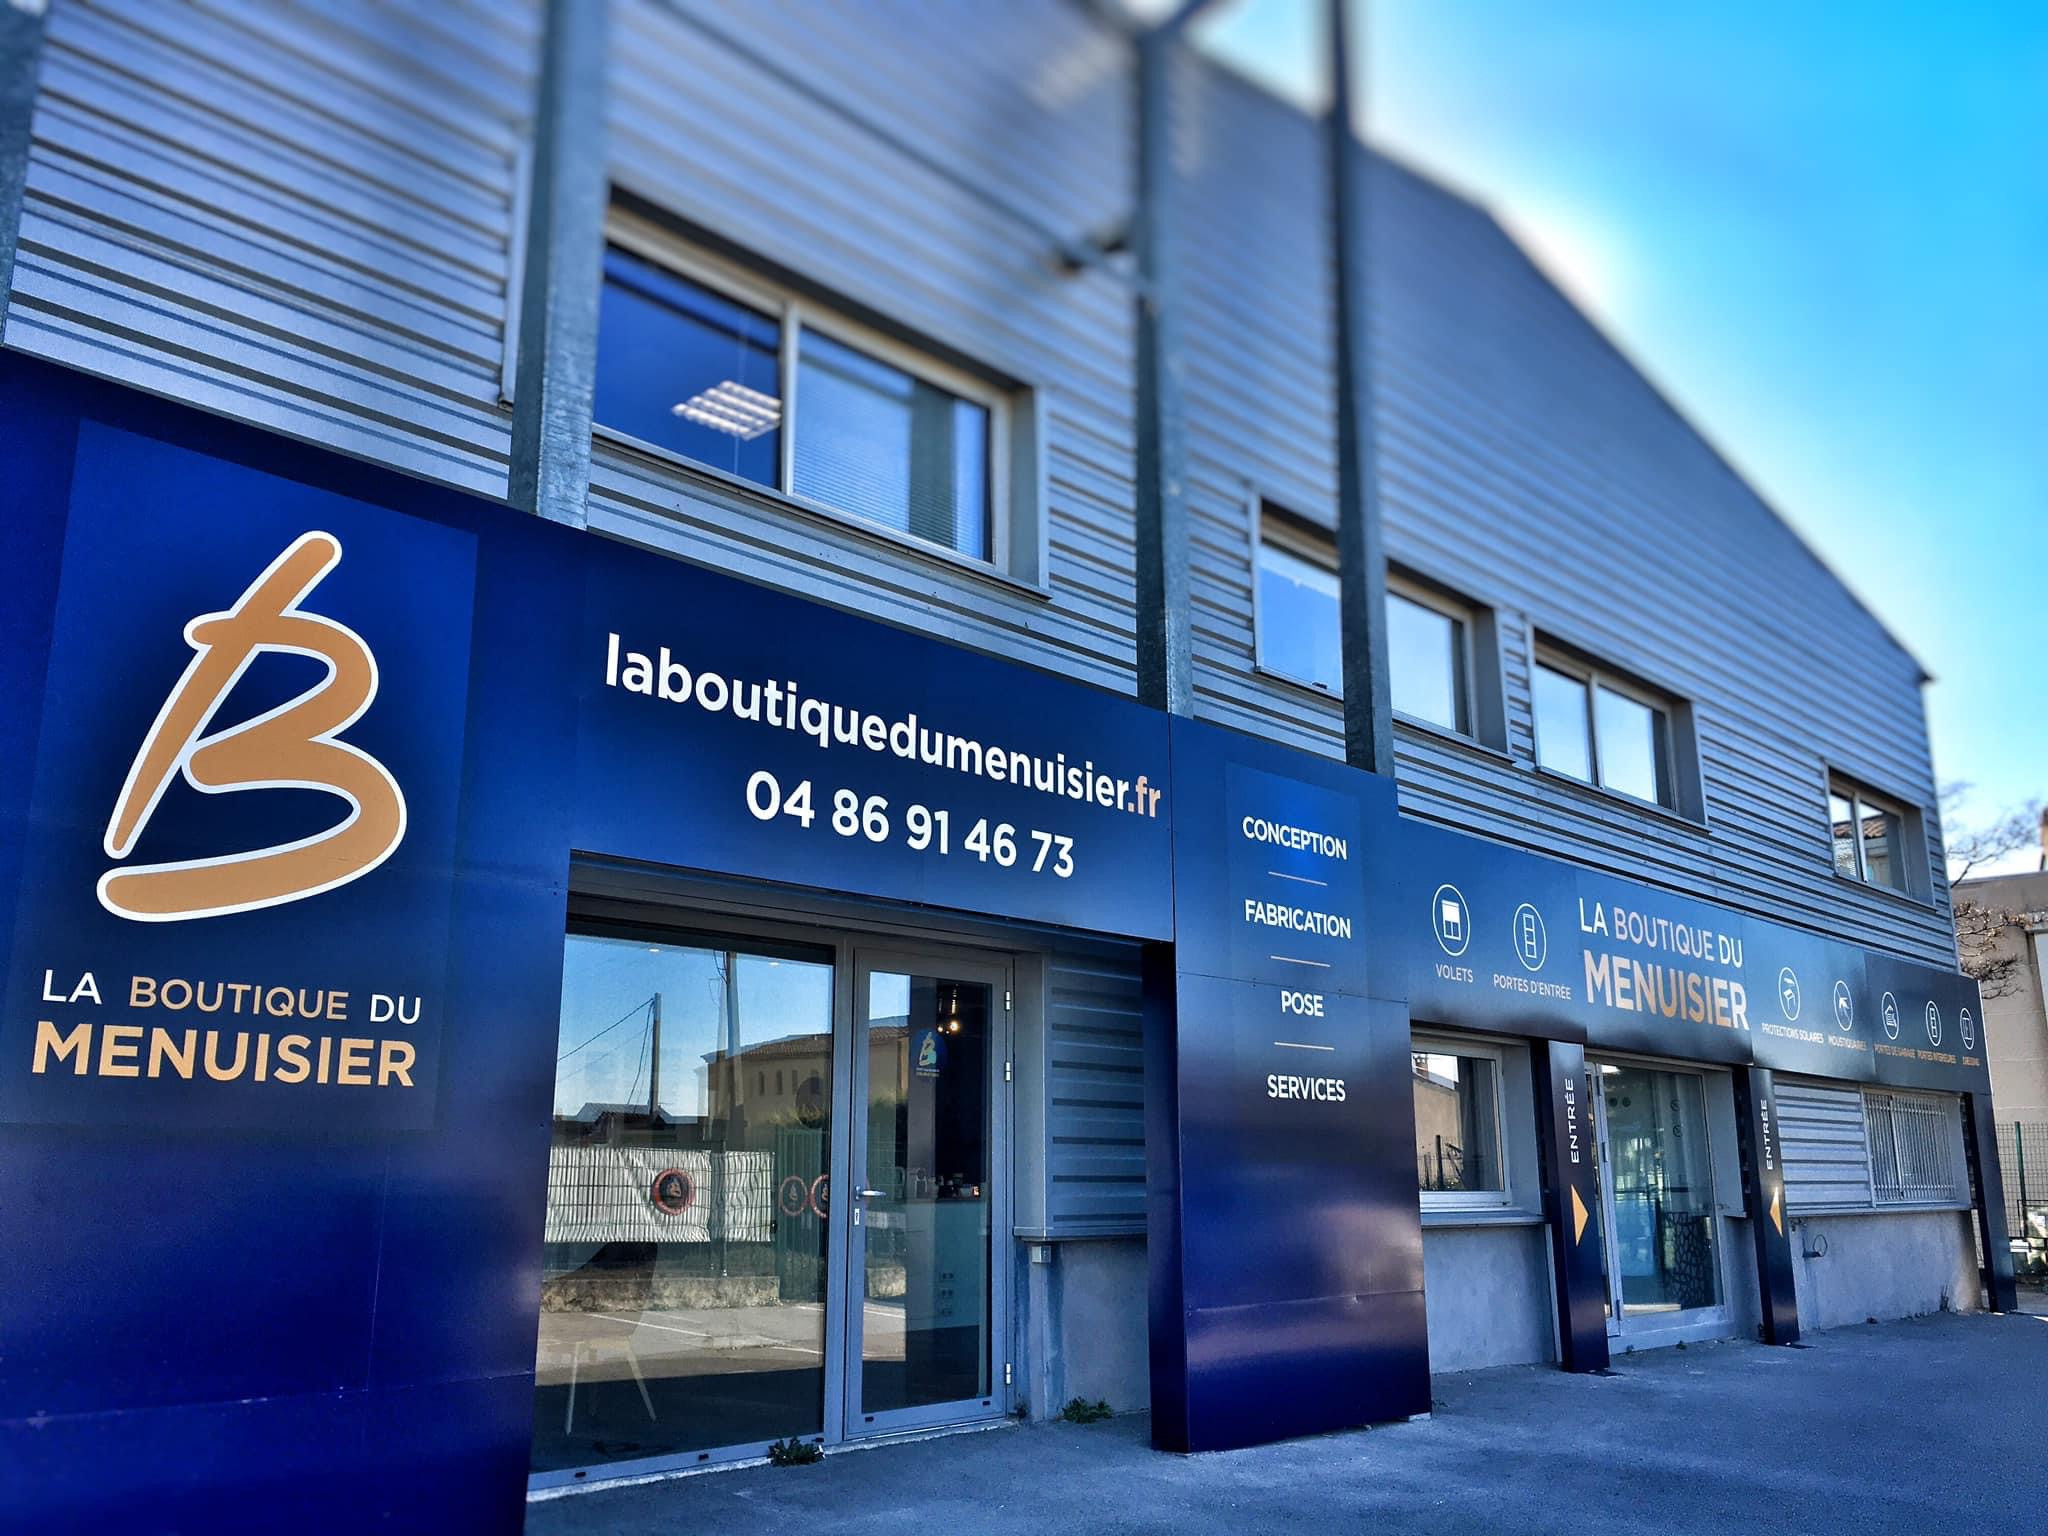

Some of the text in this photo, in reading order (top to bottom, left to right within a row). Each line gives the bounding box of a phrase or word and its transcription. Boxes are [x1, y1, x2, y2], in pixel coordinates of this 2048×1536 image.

[606, 632, 1161, 819] laboutiquedumenuisier.fr
[746, 770, 1074, 878] 04 86 91 46 73
[1242, 816, 1347, 860] CONCEPTION
[1244, 899, 1351, 939] FABRICATION
[1579, 897, 1743, 968] LA BOUTIQUE DU
[42, 969, 422, 1025] LA BOUTIQUE DU
[1281, 990, 1324, 1017] POSE
[1435, 963, 1474, 983] VOLETS
[1493, 974, 1529, 993] PORTES
[1584, 949, 1750, 1031] MENUISIER
[31, 1021, 417, 1087] MENUISIER
[1267, 1074, 1346, 1102] SERVICES
[1564, 1078, 1580, 1164] ENTRÉE
[1761, 1098, 1774, 1170] ENTRÉE
